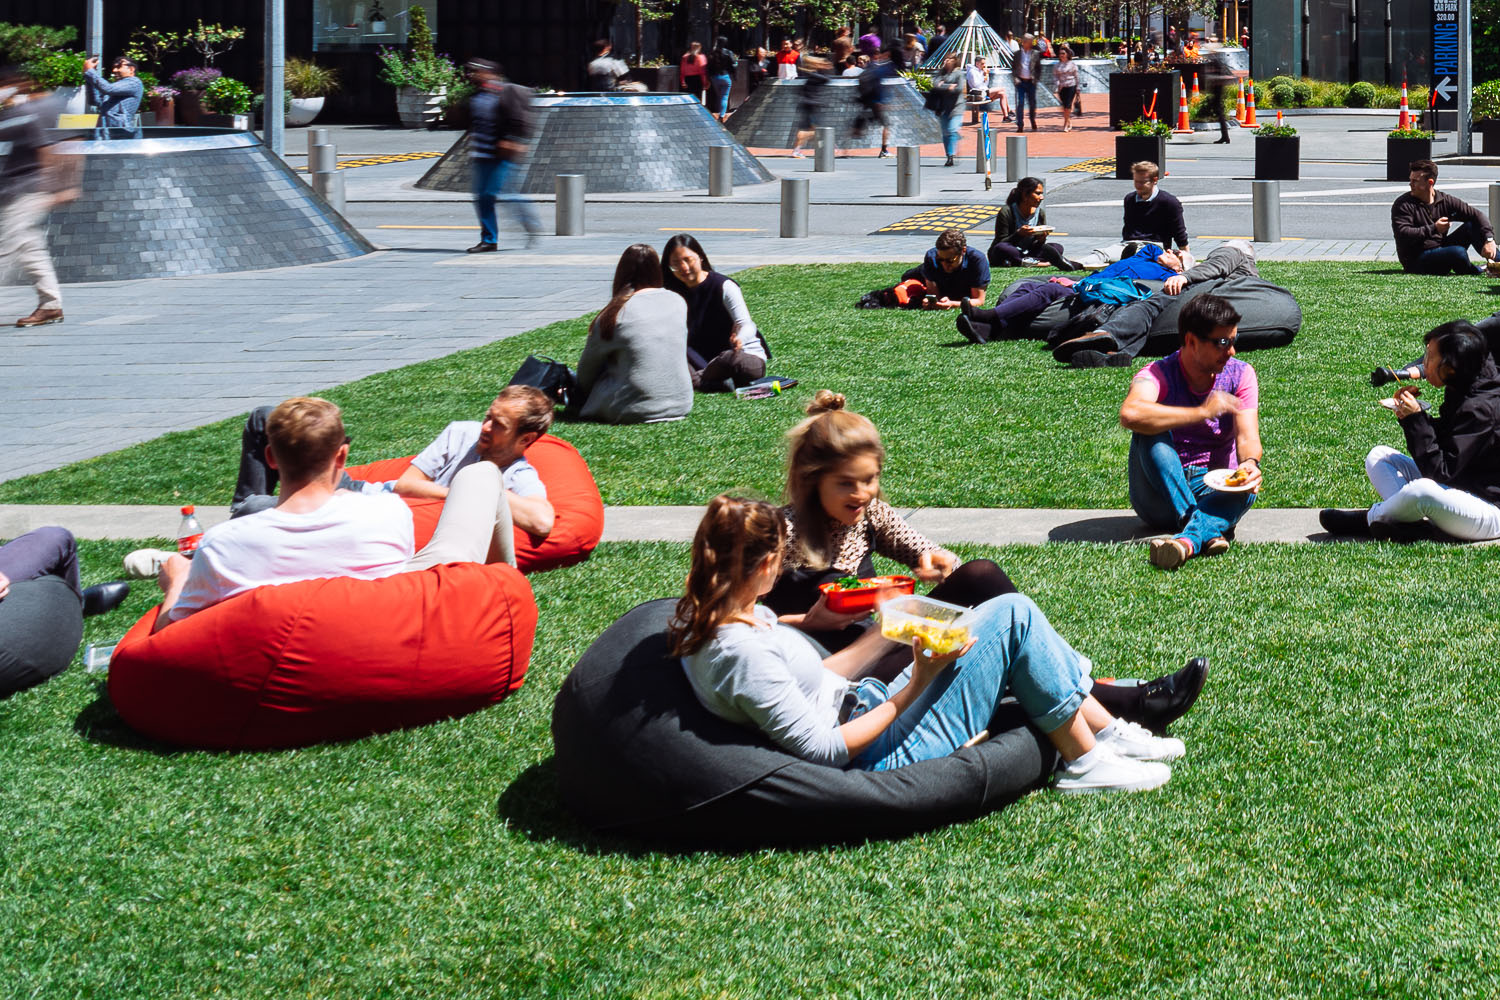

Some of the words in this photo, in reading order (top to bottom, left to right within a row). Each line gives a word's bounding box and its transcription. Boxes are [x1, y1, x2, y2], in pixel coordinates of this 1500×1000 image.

[1433, 4, 1445, 12] CAR
[1445, 4, 1458, 12] PARK
[1436, 13, 1455, 21] $20.00
[1433, 23, 1458, 75] PARKING
